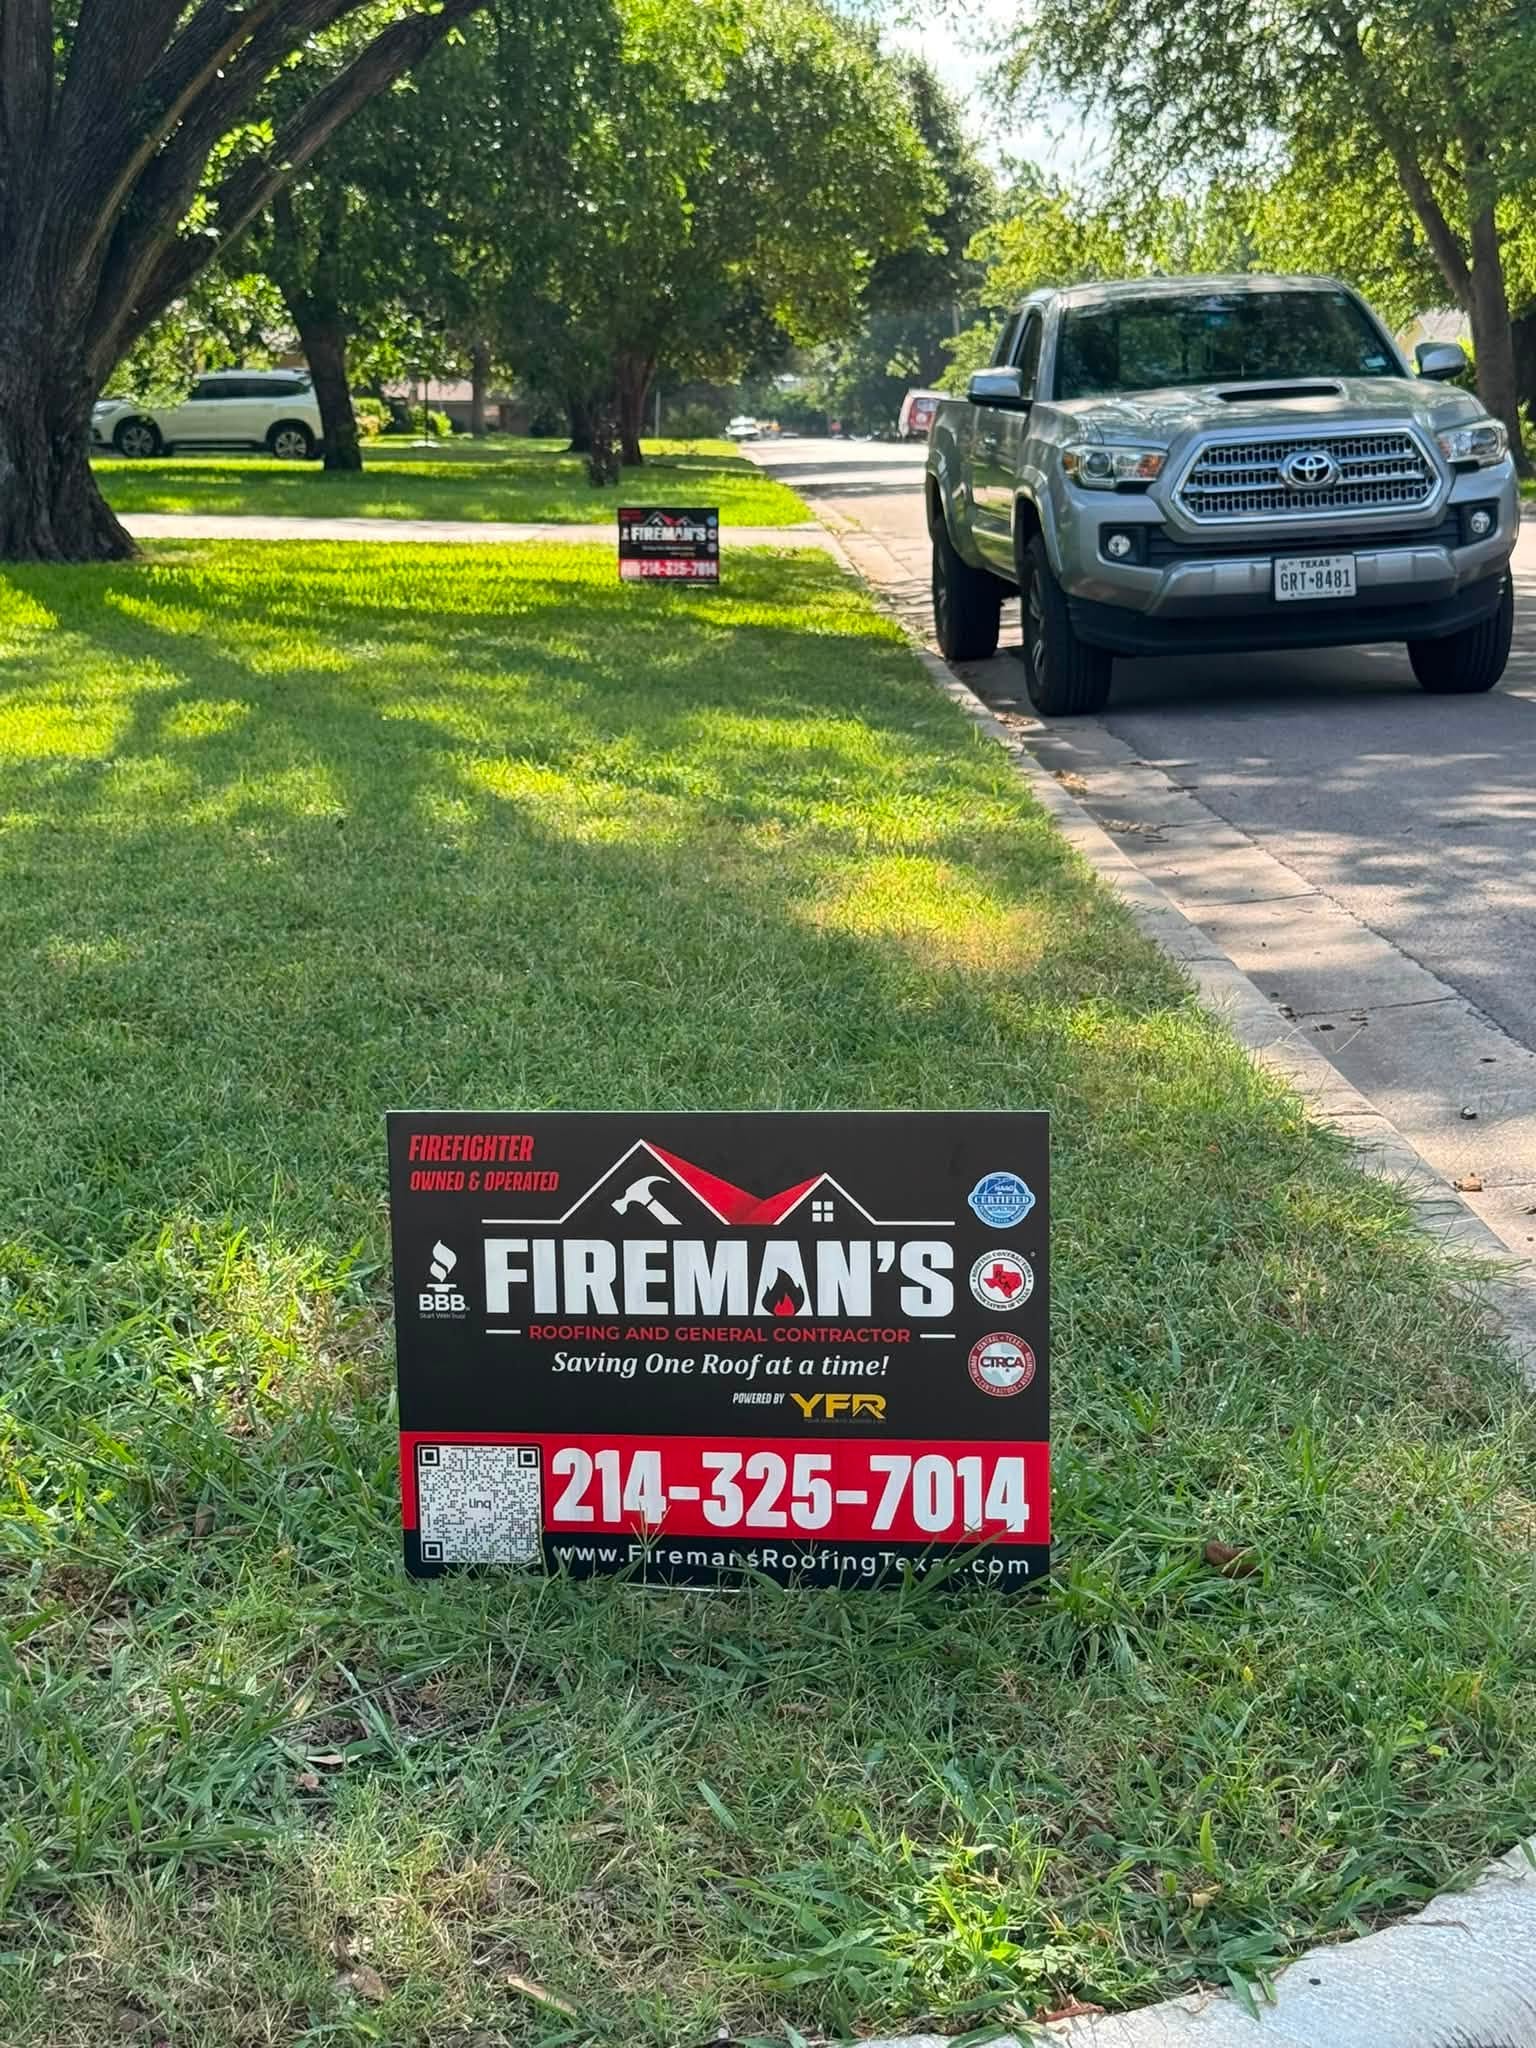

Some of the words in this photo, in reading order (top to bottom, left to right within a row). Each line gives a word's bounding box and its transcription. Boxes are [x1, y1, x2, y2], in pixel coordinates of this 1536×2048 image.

[631, 527, 706, 541] FIREMAN'S
[1300, 559, 1330, 568] TEXAS
[409, 1134, 534, 1161] FIREFIGHTER
[410, 1170, 465, 1191] OWNED
[468, 1171, 480, 1191] &
[484, 1171, 559, 1191] OPERATED
[974, 1195, 1029, 1204] CERTIFIED
[484, 1239, 954, 1317] FIREMAN'S
[419, 1294, 466, 1311] BBB
[528, 1325, 620, 1341] ROOFING
[625, 1327, 669, 1341] AND
[675, 1327, 767, 1342] GENERAL
[773, 1327, 910, 1343] CONTRACTOR
[552, 1351, 638, 1379] Saving
[645, 1353, 695, 1374] One
[701, 1353, 763, 1381] Roof
[765, 1356, 793, 1375] at
[798, 1358, 814, 1375] a
[821, 1354, 889, 1376] time!
[980, 1356, 1024, 1368] CTRCA
[732, 1392, 771, 1405] POWERED
[773, 1393, 785, 1404] BY
[790, 1393, 886, 1419] YFR
[552, 1447, 1030, 1533] 214-325-7014
